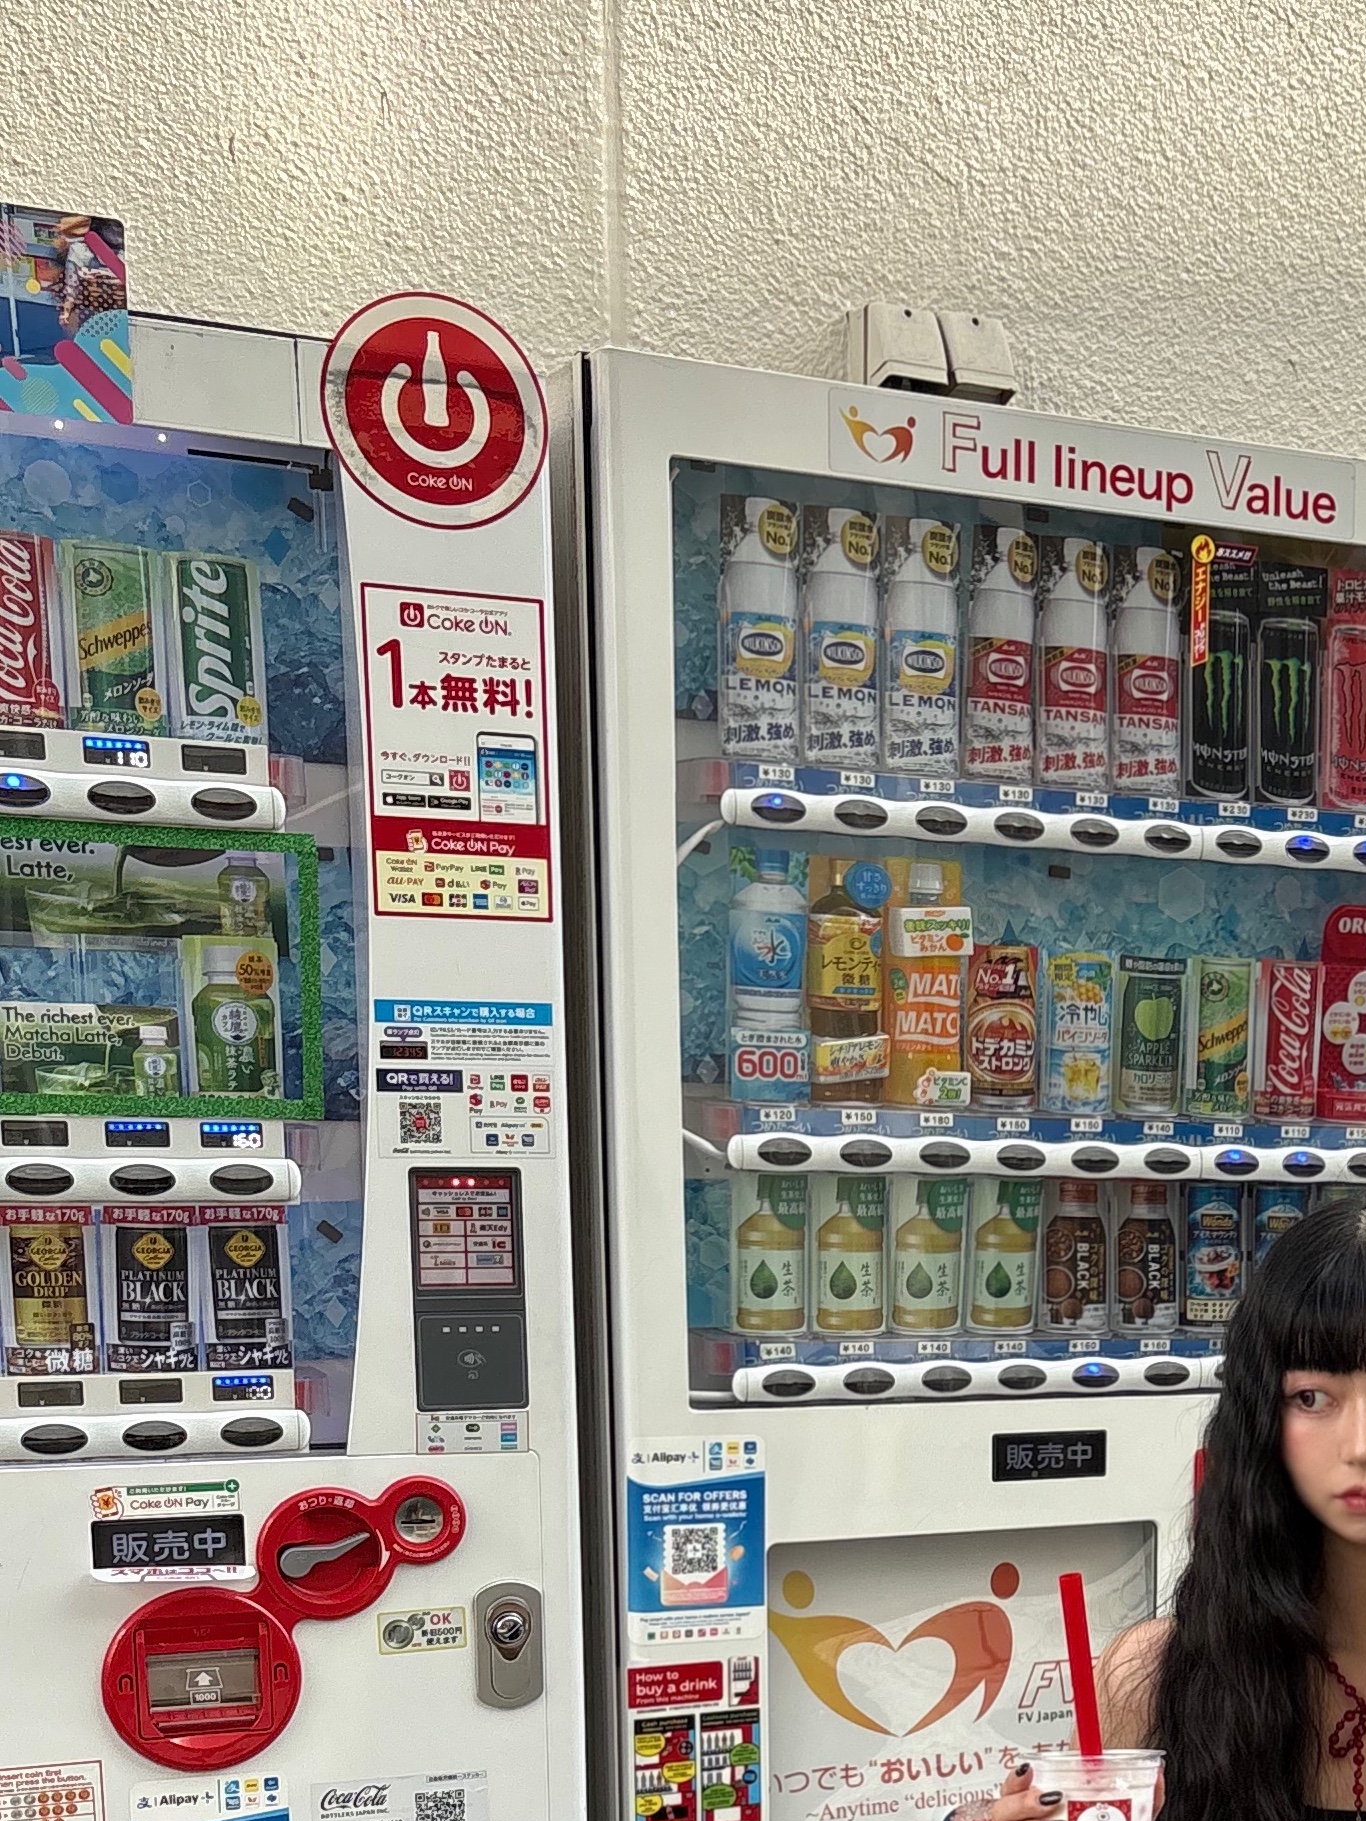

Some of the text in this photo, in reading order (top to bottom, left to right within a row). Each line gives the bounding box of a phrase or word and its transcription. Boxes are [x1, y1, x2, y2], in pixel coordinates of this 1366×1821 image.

[941, 411, 1337, 525] Full lineup Value
[407, 471, 446, 489] Coke
[765, 530, 794, 548] No.1
[1262, 569, 1304, 583] Unleash
[427, 613, 475, 632] Coke
[184, 560, 230, 720] Sprite
[438, 651, 531, 671] スタンプたまると
[376, 638, 533, 719] 1本無料!
[725, 677, 796, 697] LEMON
[807, 685, 877, 704] LEMON
[723, 722, 795, 745] 刺激、強め
[806, 730, 876, 752] 刺激、強め
[762, 767, 792, 780] ¥130
[843, 774, 873, 786] ¥130
[923, 781, 952, 792] ¥130
[1222, 804, 1248, 815] ¥230
[1290, 809, 1316, 821] ¥230
[39, 837, 96, 856] ever.
[431, 838, 465, 851] Coke
[490, 843, 516, 856] Pay
[6, 855, 74, 882] Latte,
[435, 863, 464, 873] PayPay
[388, 892, 416, 904] VISA
[841, 972, 871, 987] 微糖
[2, 1007, 136, 1028] The richest ever.
[1058, 1003, 1107, 1026] 冷やし
[5, 1025, 123, 1045] Matcha Latte,
[5, 1043, 65, 1061] Debut.
[386, 1072, 454, 1086] QRで買える!
[763, 1109, 793, 1120] ¥120
[844, 1111, 873, 1122] ¥150
[1147, 1124, 1171, 1134] ¥140
[1217, 1126, 1240, 1135] ¥110
[1284, 1128, 1307, 1137] ¥110
[215, 1267, 277, 1280] PLATINUM
[1075, 1243, 1089, 1290] BLACK
[15, 1270, 84, 1288] GOLDEN
[121, 1269, 186, 1282] PLATINUM
[781, 1261, 796, 1298] 生茶
[860, 1262, 874, 1298] 生茶
[33, 1286, 70, 1299] DRIP
[121, 1281, 187, 1303] BLACK
[216, 1278, 280, 1300] BLACK
[764, 1345, 793, 1356] ¥140
[1071, 1342, 1097, 1351] ¥160
[1142, 1341, 1167, 1350] ¥160
[651, 1452, 686, 1466] Alipay
[1005, 1441, 1094, 1471] 販売中
[129, 1498, 162, 1511] Coke
[185, 1496, 210, 1510] Pay
[642, 1490, 747, 1504] SCAN FOR OFFERS
[112, 1527, 227, 1564] 販売中
[429, 1612, 453, 1626] OK
[636, 1670, 679, 1684] How to
[635, 1676, 718, 1699] buy a drink
[194, 1691, 219, 1704] 1000
[636, 1693, 700, 1705] From this machine
[1017, 1707, 1073, 1723] FV Japan
[159, 1791, 200, 1807] Alipay
